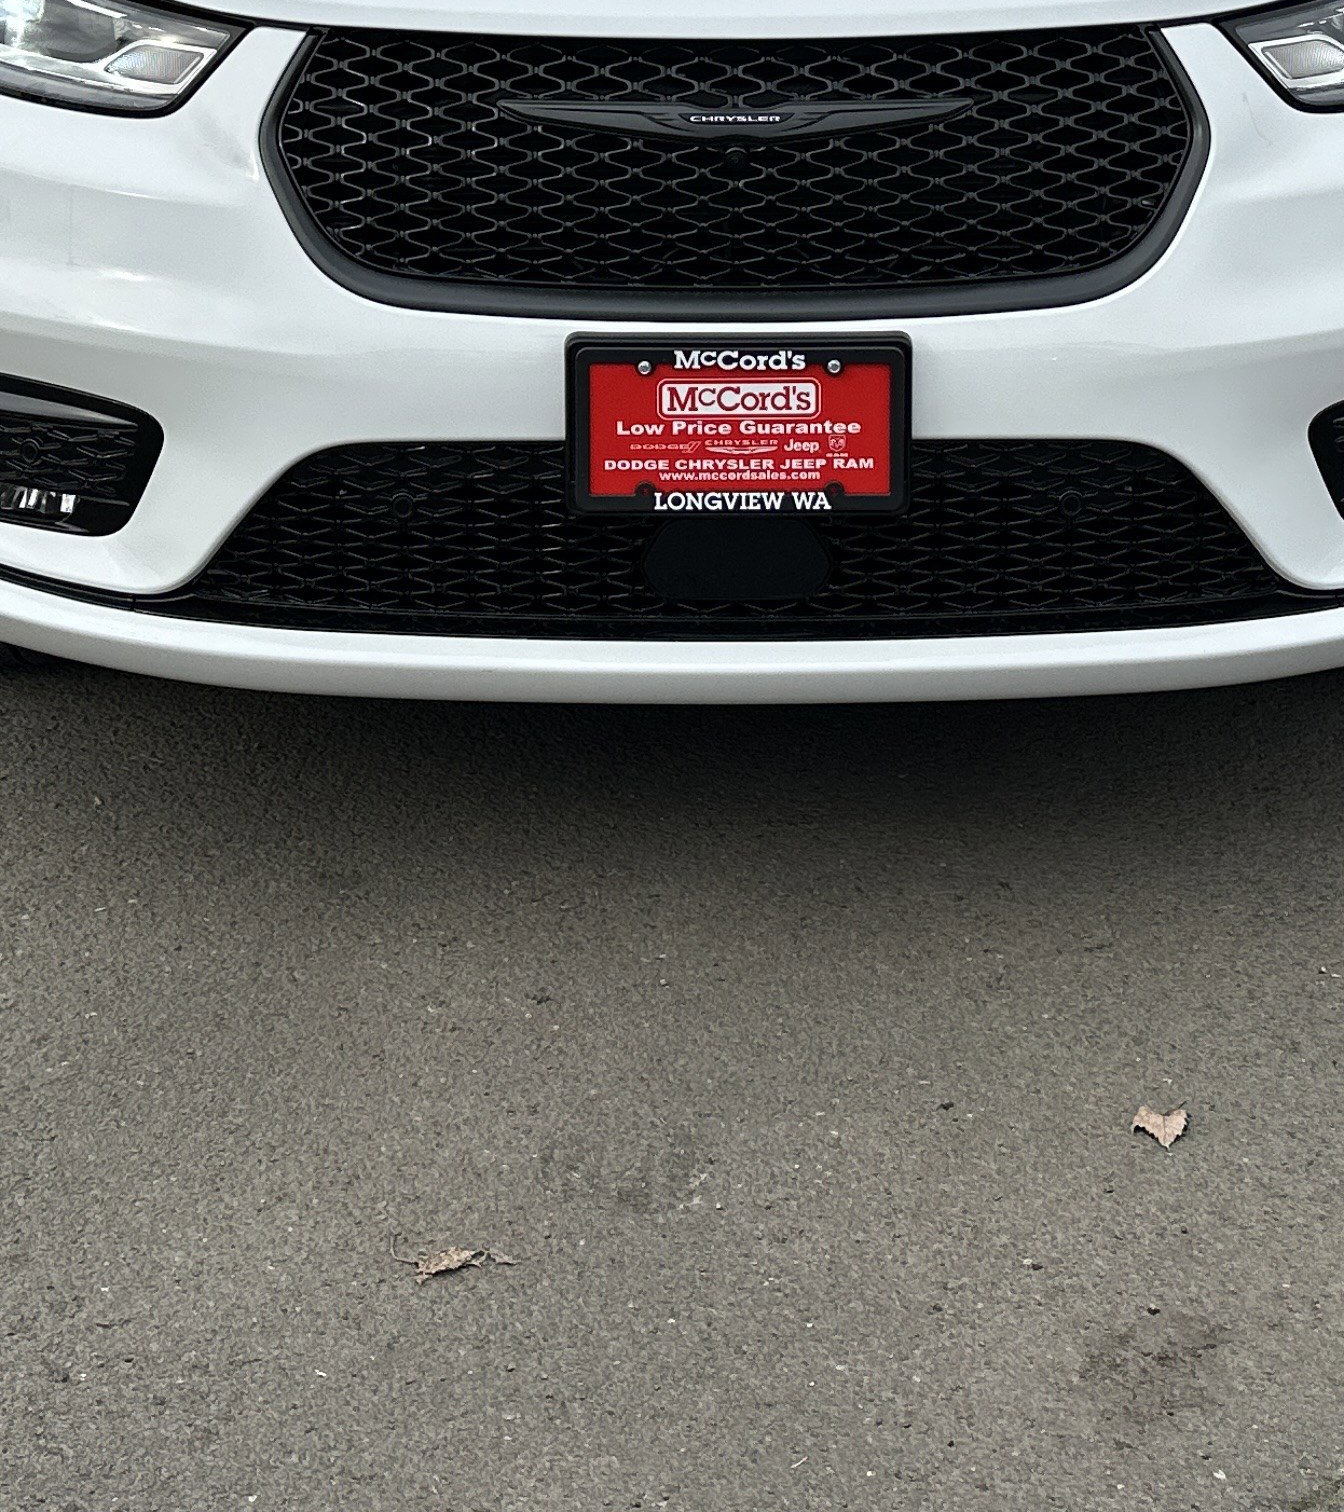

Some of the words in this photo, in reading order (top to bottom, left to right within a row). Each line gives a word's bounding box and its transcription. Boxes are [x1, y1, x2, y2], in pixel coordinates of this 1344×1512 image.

[673, 349, 806, 371] McCord's
[666, 386, 812, 412] McCord's
[616, 420, 665, 436] Low
[672, 420, 732, 436] Price
[739, 419, 862, 435] Guarantee
[783, 437, 820, 453] Jeep
[604, 459, 670, 471] DODGE
[674, 459, 775, 471] CHRYSLER
[779, 458, 827, 470] JEEP
[833, 457, 874, 470] RAM
[658, 469, 821, 482] www.mccordsales.com
[654, 491, 786, 511] LONGVIEW
[791, 491, 832, 511] WA
